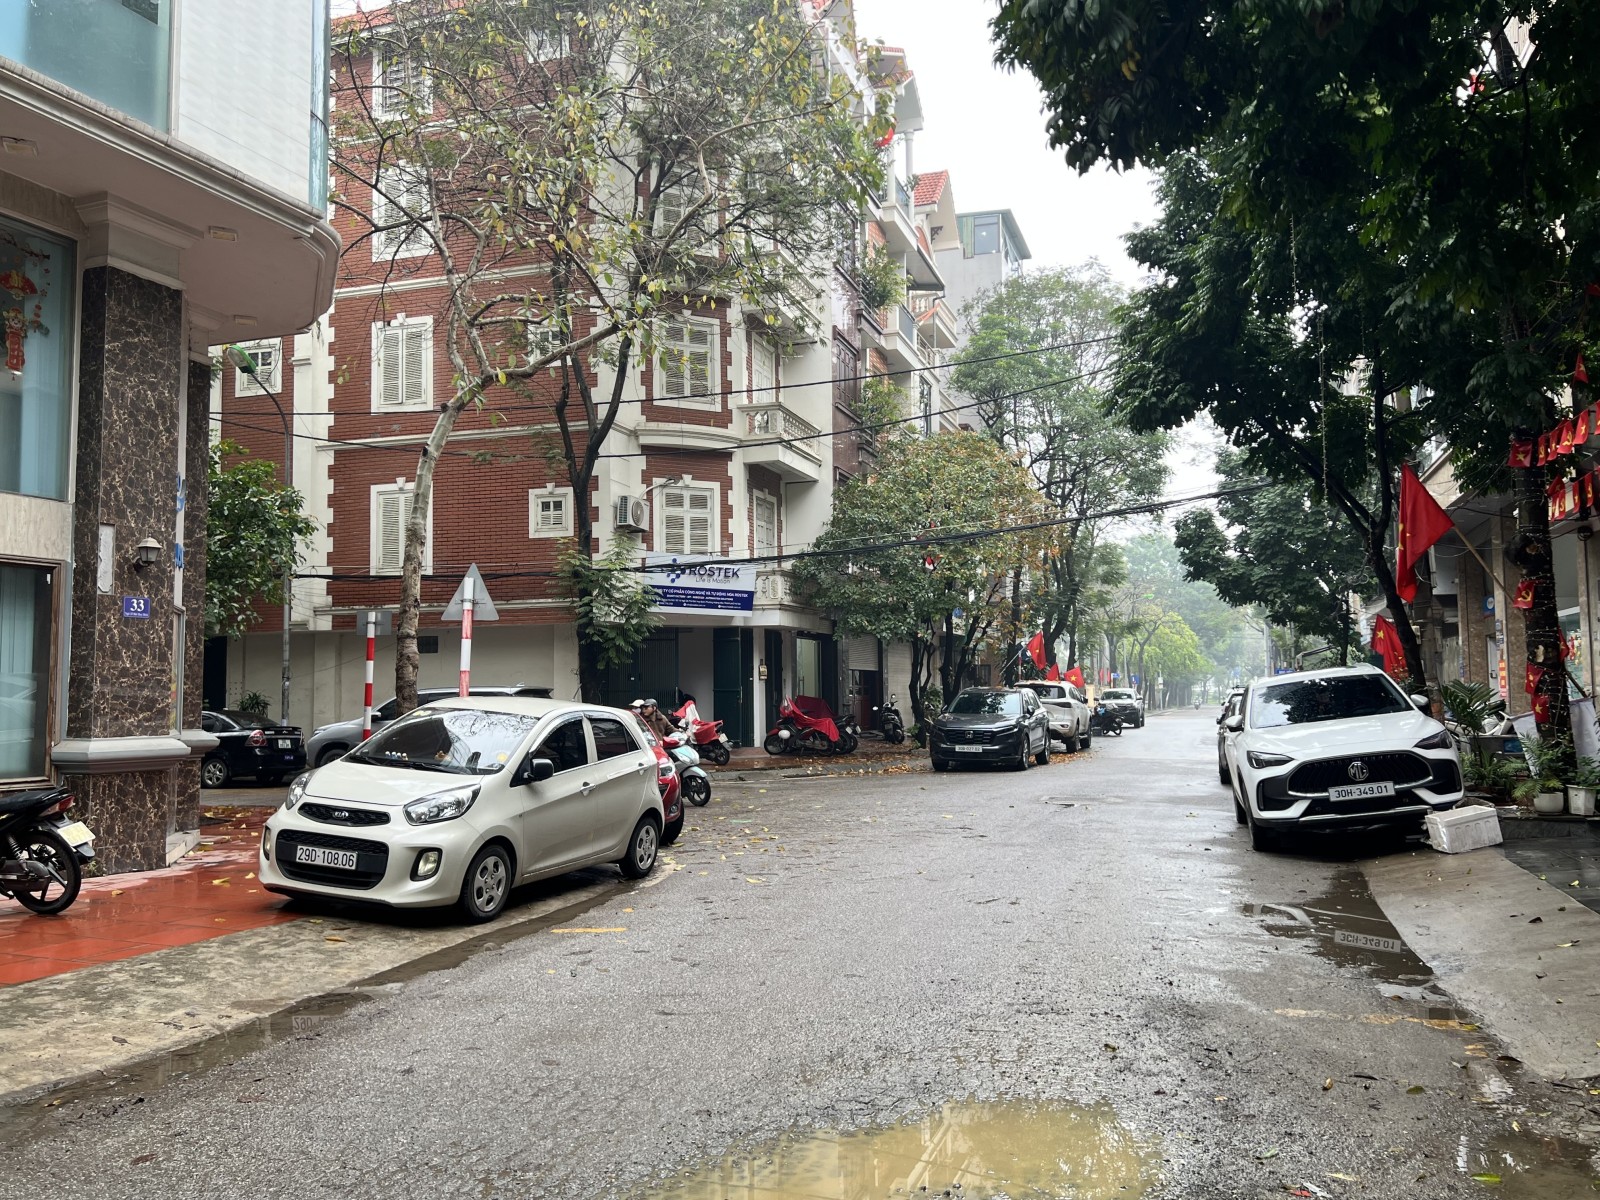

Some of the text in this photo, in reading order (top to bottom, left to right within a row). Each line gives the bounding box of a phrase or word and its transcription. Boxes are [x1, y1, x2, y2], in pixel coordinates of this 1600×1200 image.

[688, 566, 740, 578] ROSTEK
[130, 598, 145, 612] 33
[1349, 763, 1368, 781] MG
[1334, 785, 1389, 798] 30H-349.01
[334, 810, 349, 819] KIA
[297, 847, 355, 868] 29D-108.06
